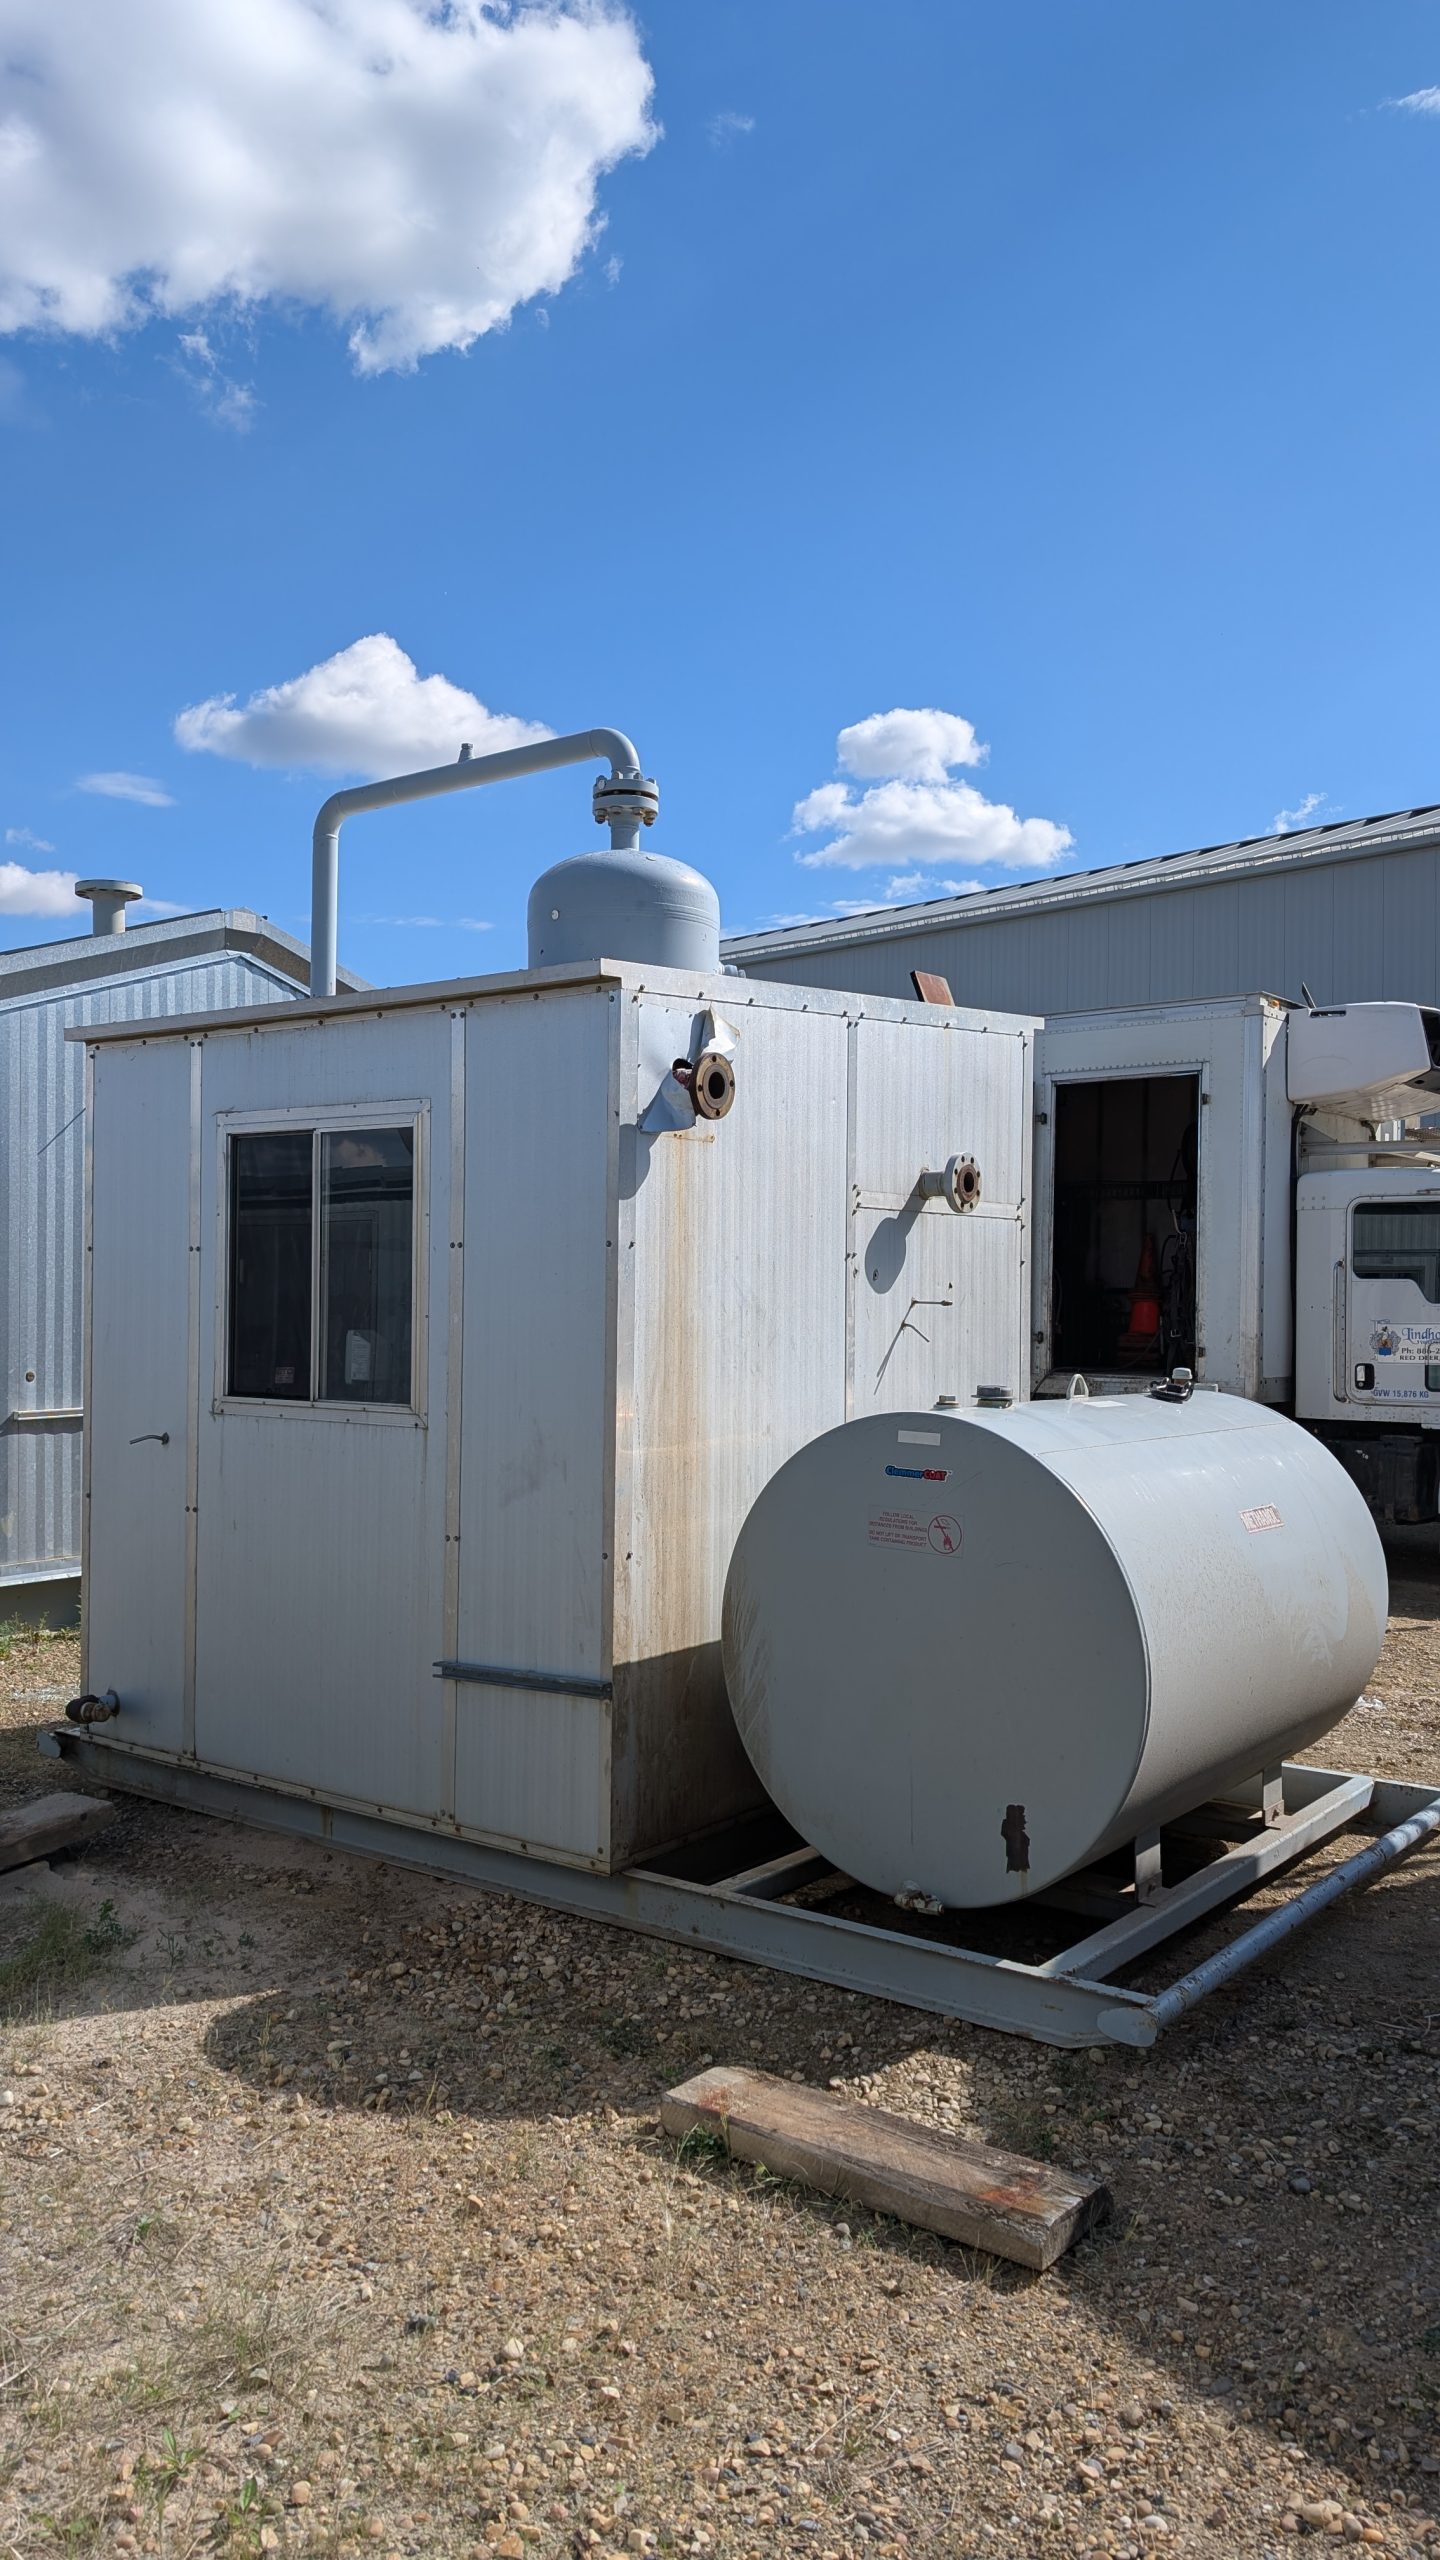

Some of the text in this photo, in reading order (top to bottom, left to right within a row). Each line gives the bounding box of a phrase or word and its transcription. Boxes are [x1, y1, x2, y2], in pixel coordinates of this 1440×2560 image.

[1373, 1389, 1390, 1397] GVW
[1392, 1390, 1417, 1398] 15,876
[1242, 1506, 1282, 1530] METHANOL
[901, 1534, 927, 1542] TRANSPORT
